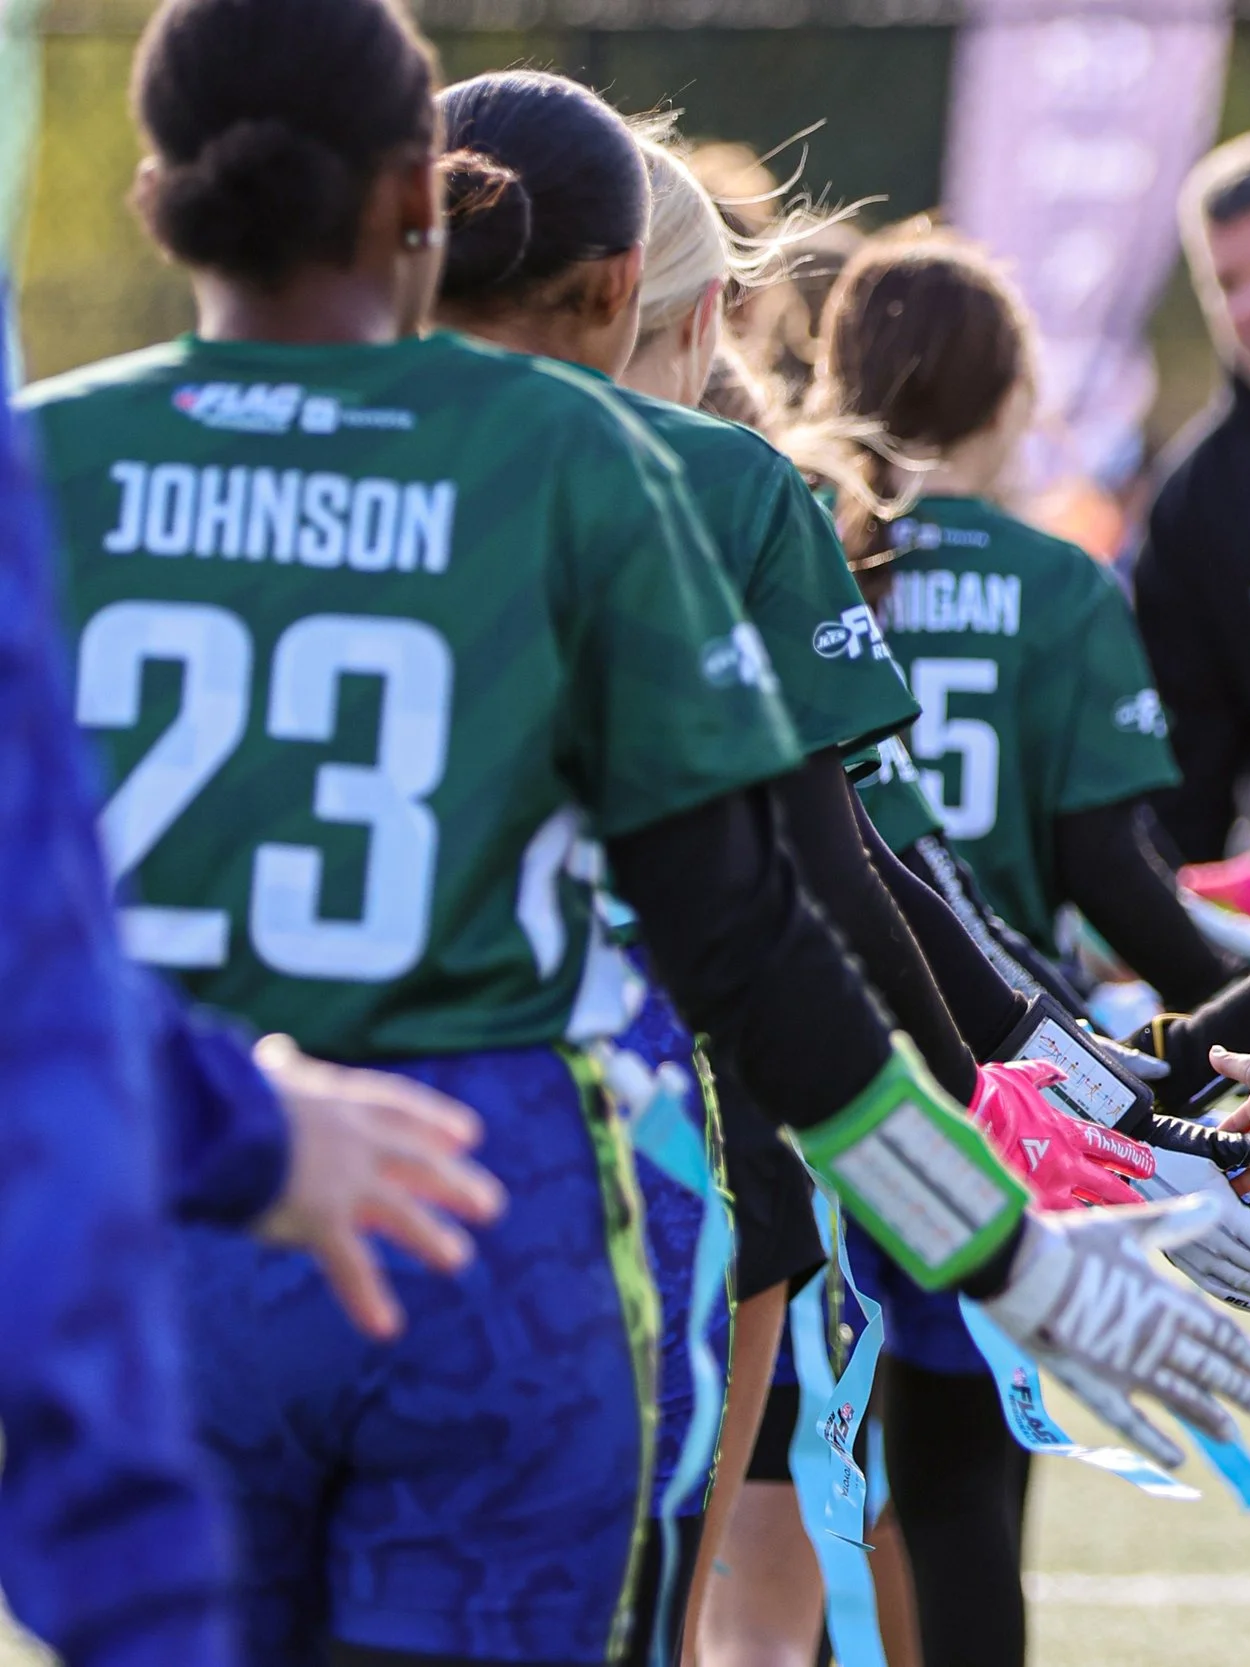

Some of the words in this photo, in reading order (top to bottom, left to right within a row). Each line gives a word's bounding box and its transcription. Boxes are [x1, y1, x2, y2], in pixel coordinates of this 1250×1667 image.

[104, 460, 457, 575] JOHNSON
[76, 600, 453, 983] 23
[911, 657, 999, 840] 5
